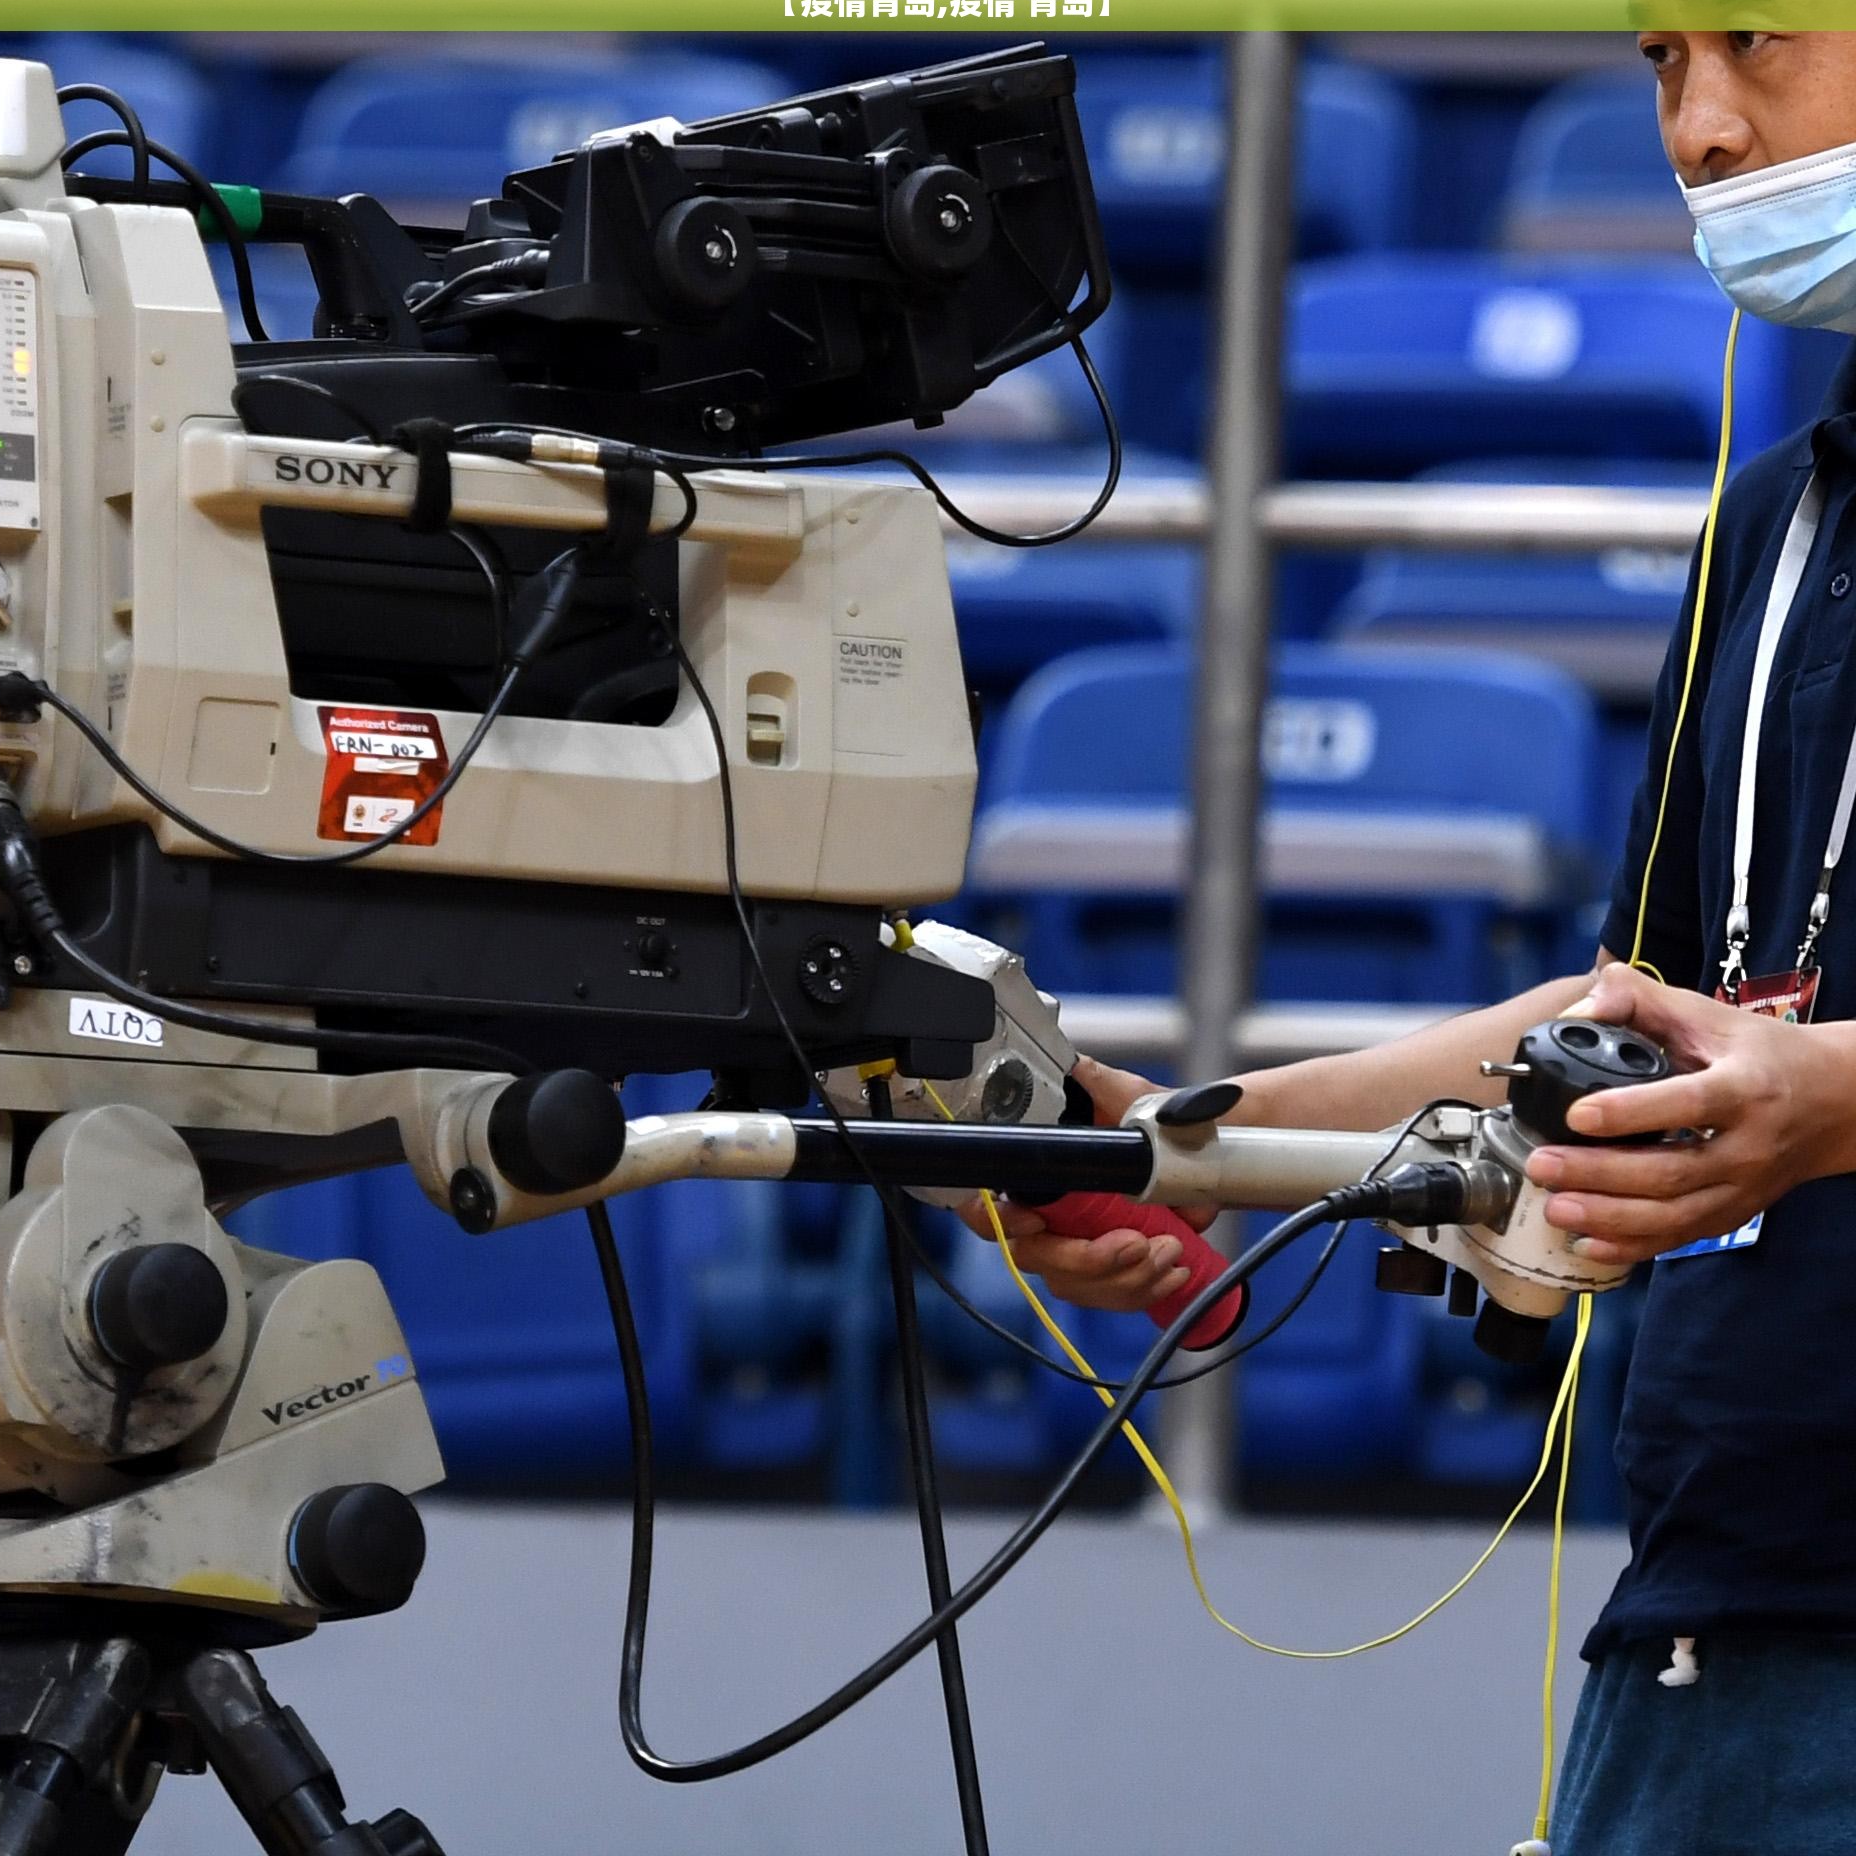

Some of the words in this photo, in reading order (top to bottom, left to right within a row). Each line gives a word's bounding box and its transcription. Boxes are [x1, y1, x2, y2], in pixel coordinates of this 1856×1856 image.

[275, 455, 399, 489] SONY
[840, 642, 902, 659] CAUTION
[262, 1375, 371, 1425] Vector
